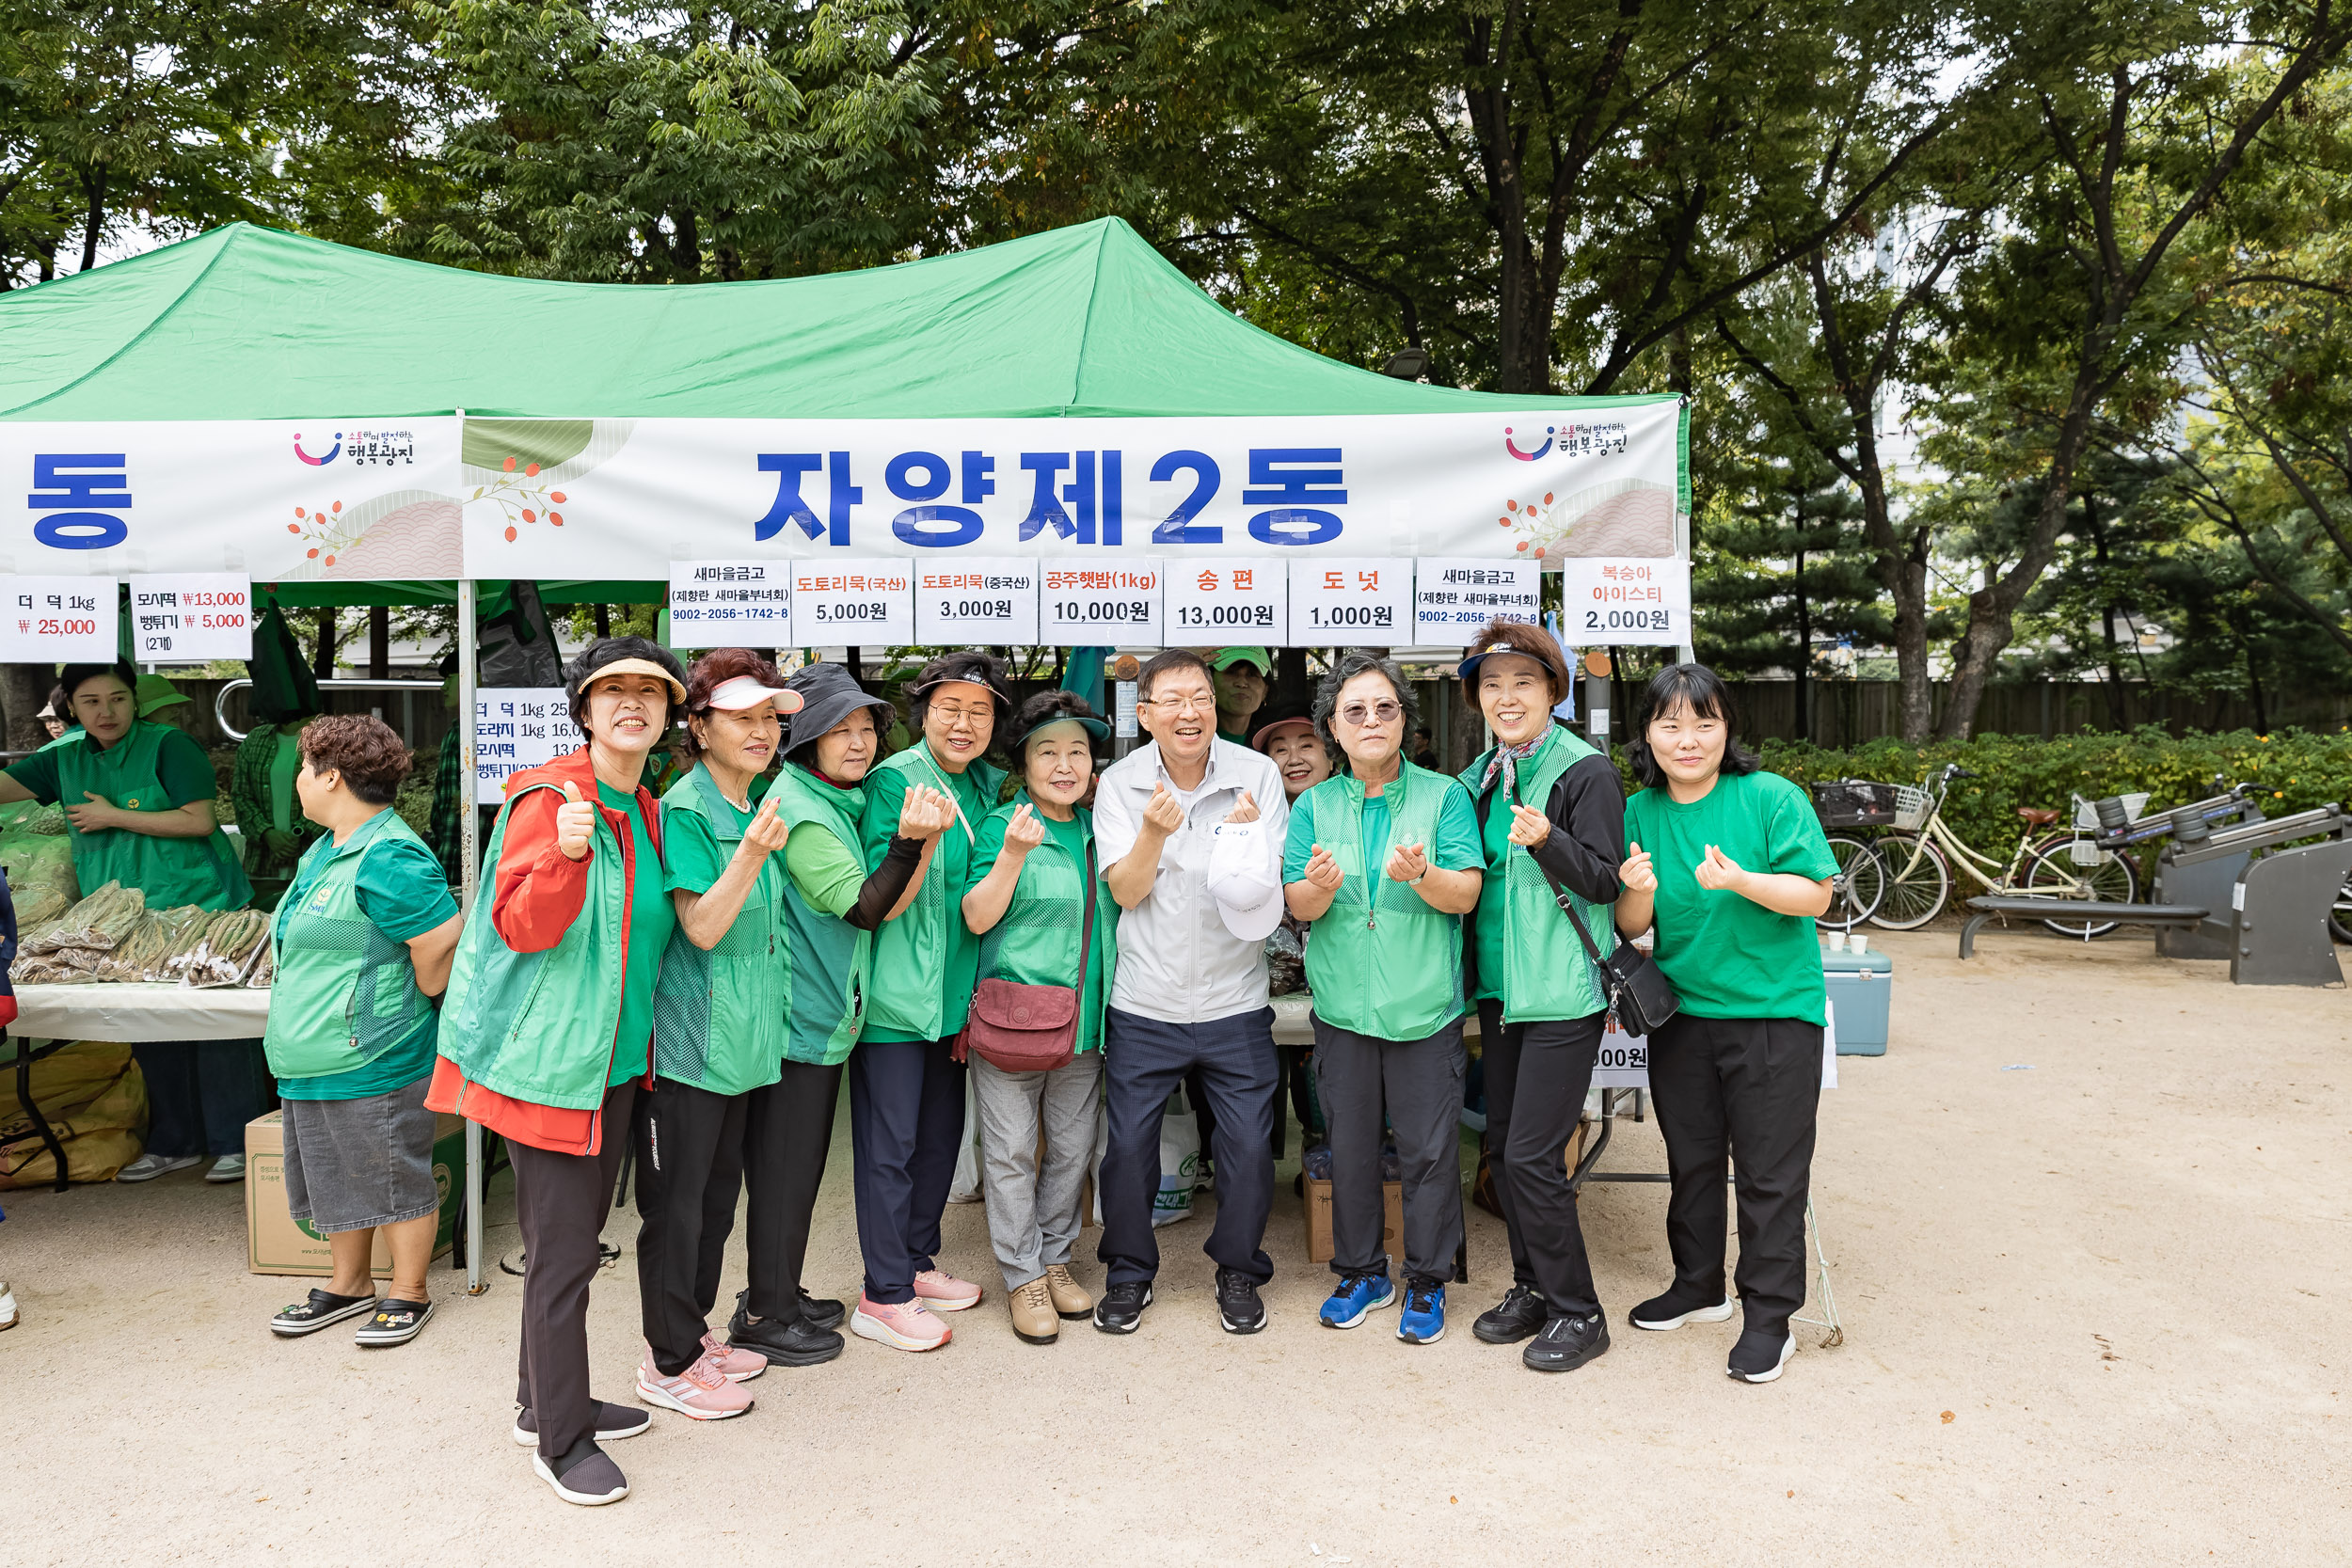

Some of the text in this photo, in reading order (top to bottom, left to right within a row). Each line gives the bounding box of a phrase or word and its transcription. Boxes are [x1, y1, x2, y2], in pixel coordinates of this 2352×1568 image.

[348, 430, 414, 444] 소통하며 발전하는
[1560, 423, 1592, 439] 소통하며
[347, 443, 413, 466] 행복광진
[1559, 435, 1627, 457] 행복광진
[28, 453, 132, 549] 동
[755, 448, 1347, 548] 자양제2동
[694, 566, 766, 582] 새마을금고
[1046, 571, 1156, 591] 공주햇밤(1kg)
[1442, 569, 1516, 584] 새마을금고
[1602, 565, 1652, 581] 복숭아
[797, 575, 907, 593] 도토리묵(국산)
[922, 574, 1030, 590] 도토리묵(중국산)
[69, 595, 96, 611] 1kg
[137, 593, 177, 608] 모시떡
[672, 589, 789, 602] (제향란 새마을부녀회)
[1418, 592, 1538, 607] (제향란 새마을부녀회)
[1593, 586, 1661, 603] 아이스티
[673, 608, 788, 620] 9002-2056-1742-8
[817, 602, 887, 622] 5,000원
[941, 599, 1012, 619] 3,000원
[1055, 601, 1149, 623] 10,000원
[1178, 605, 1274, 627] 13,000원
[1311, 606, 1392, 627] 1,000원
[38, 619, 96, 638] 25,000
[140, 614, 179, 630] 뻥튀기
[202, 613, 245, 630] 5,000
[1585, 610, 1670, 631] 2,000원
[146, 636, 172, 652] (2개)
[520, 702, 545, 719] 1kg
[476, 722, 515, 738] 도라지
[520, 722, 546, 738] 1kg
[477, 742, 516, 758] 모시떡
[1595, 1047, 1647, 1069] 00원
